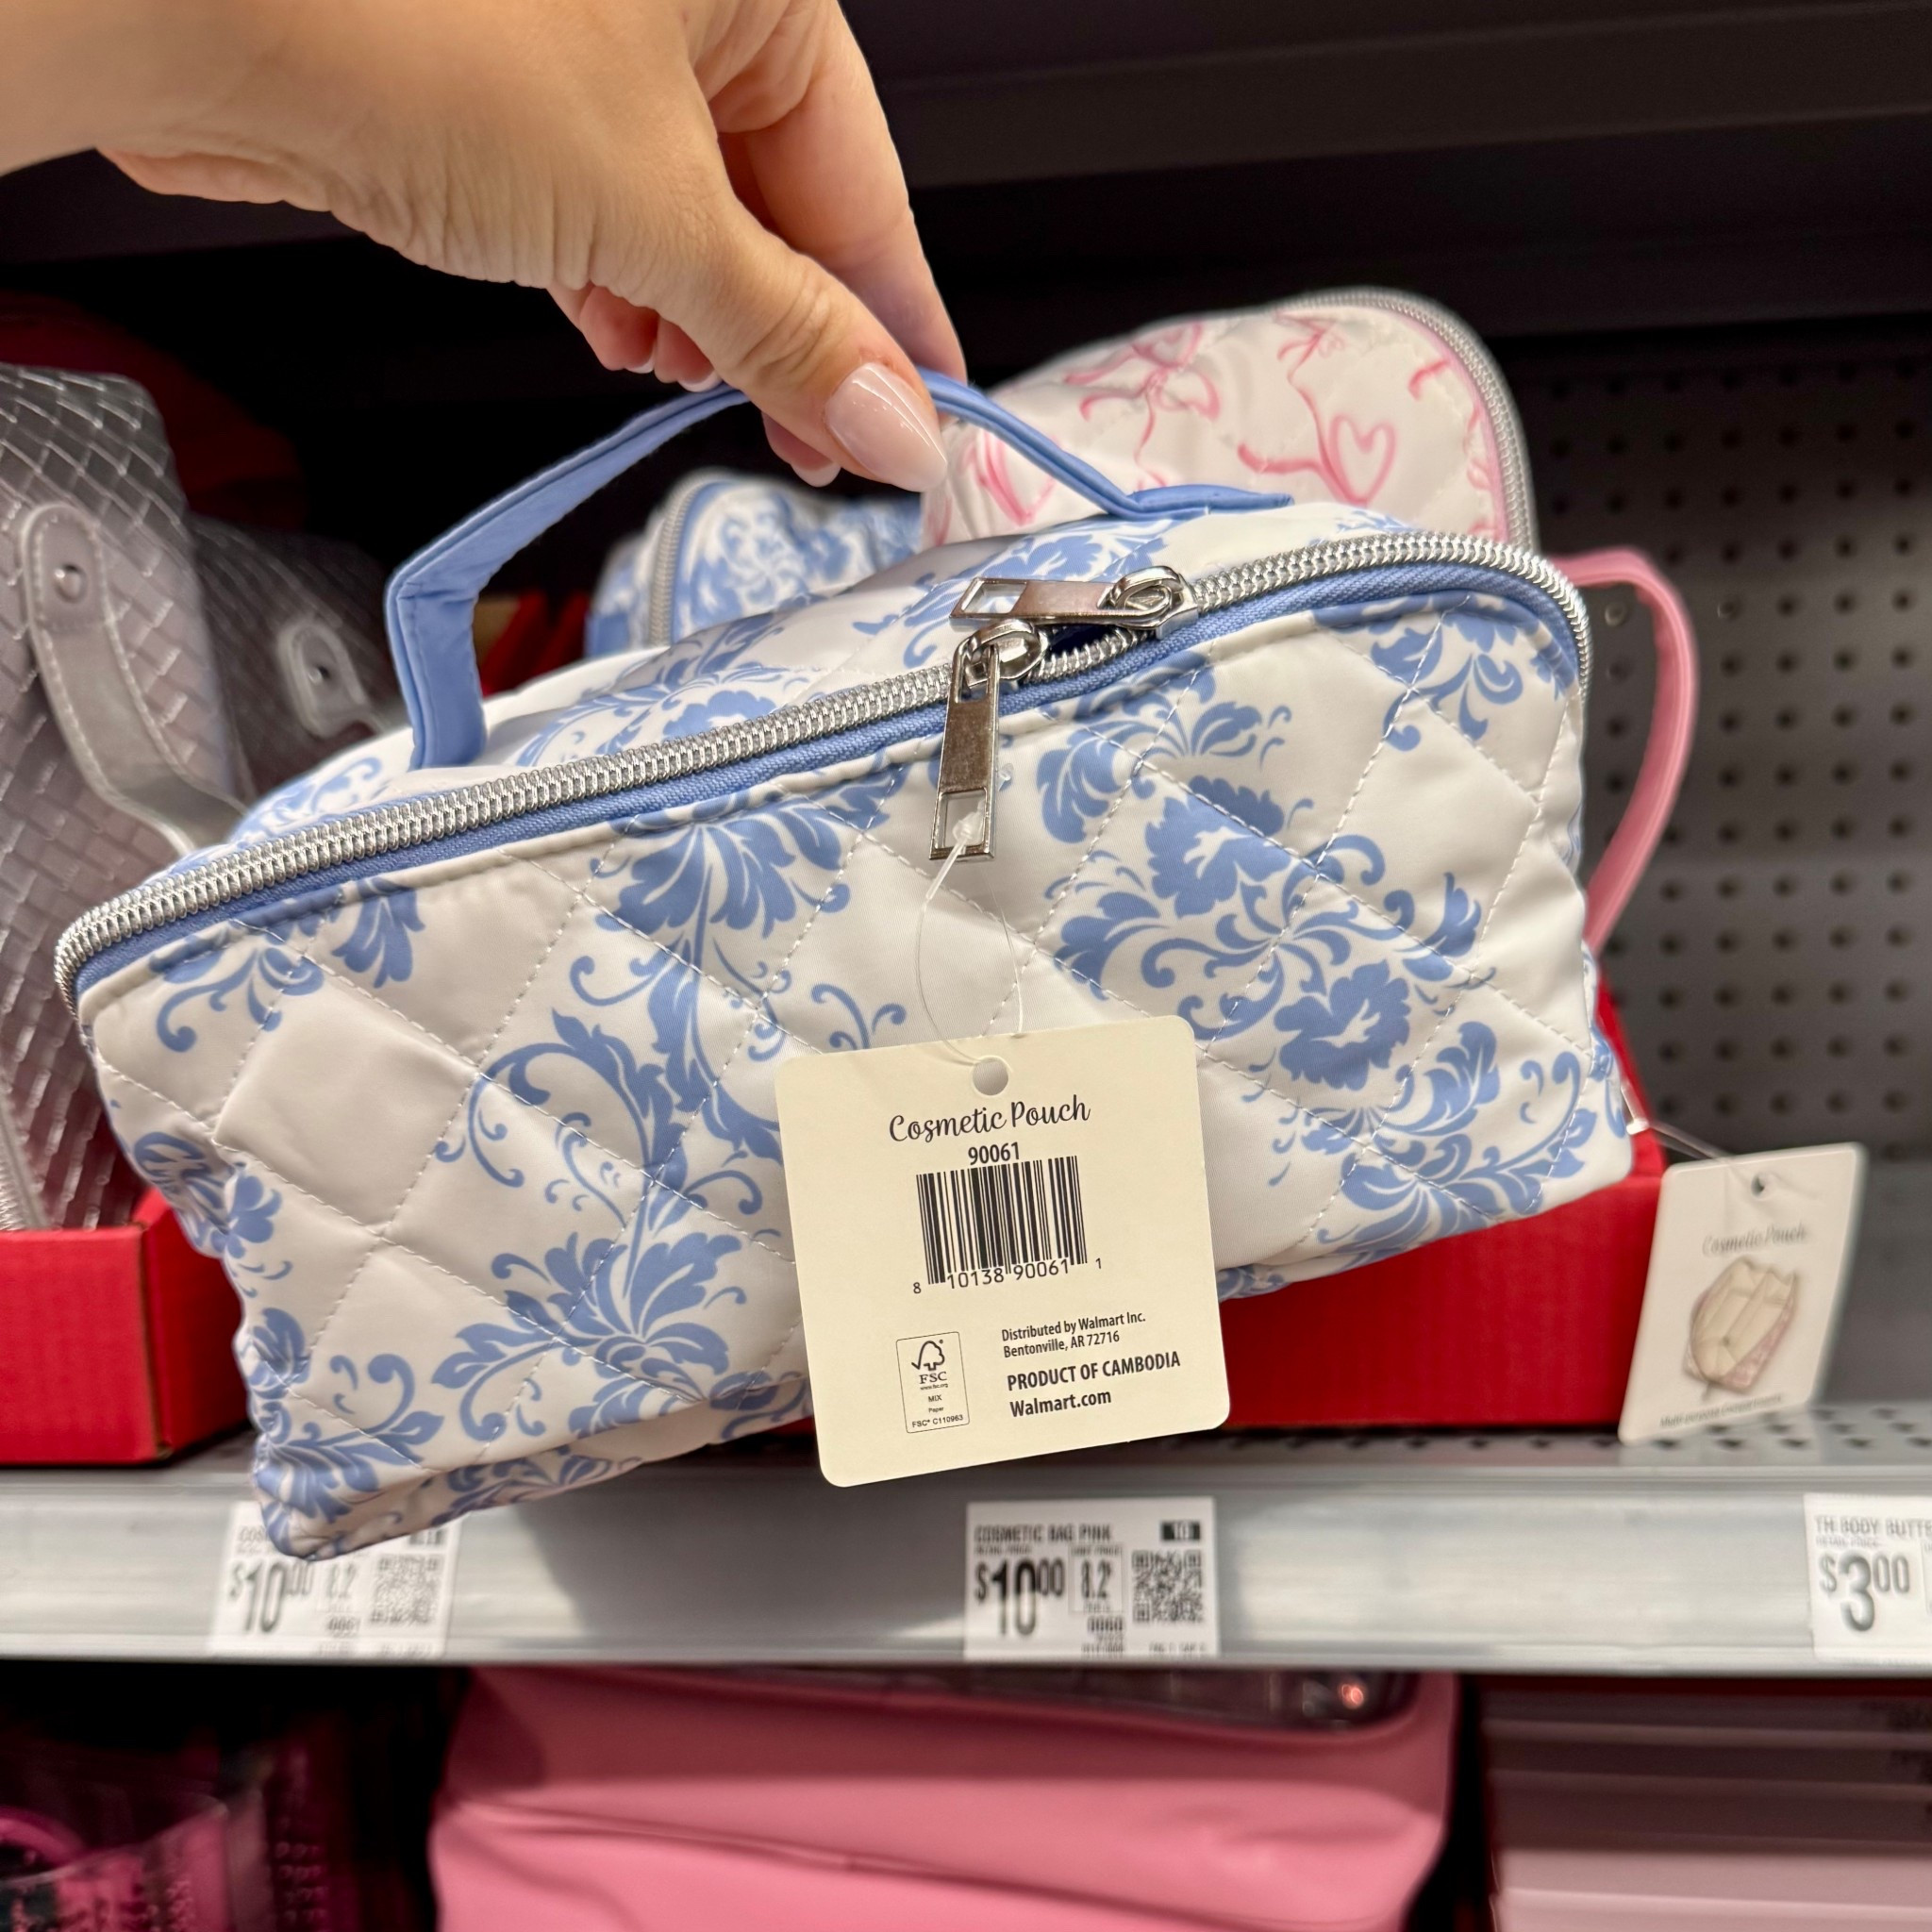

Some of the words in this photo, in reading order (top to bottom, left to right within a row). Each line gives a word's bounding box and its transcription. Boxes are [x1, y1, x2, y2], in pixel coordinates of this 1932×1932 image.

[889, 1107, 1007, 1142] Cosmetic
[1010, 1094, 1091, 1127] Pouch
[968, 1141, 1020, 1165] 90061
[913, 1282, 922, 1294] 8
[947, 1268, 1005, 1289] 10138
[1013, 1258, 1069, 1280] 90061
[1095, 1257, 1102, 1270] 1
[1001, 1322, 1061, 1341] Distributed
[1063, 1321, 1076, 1335] by
[1078, 1314, 1124, 1331] Walmart
[1126, 1311, 1146, 1324] Inc.
[1003, 1338, 1068, 1358] Bentonville,
[1071, 1335, 1085, 1349] AR
[1087, 1330, 1120, 1346] 72716
[919, 1371, 947, 1384] FSC
[1007, 1365, 1076, 1391] PRODUCT
[1080, 1362, 1098, 1380] OF
[1102, 1351, 1181, 1377] CAMBODIA
[927, 1394, 942, 1403] MIX
[1009, 1391, 1112, 1417] Walmart.com
[932, 1414, 964, 1425] C110963
[974, 1524, 1042, 1542] COSMETIC
[1079, 1524, 1111, 1541] PINK
[1840, 1517, 1879, 1535] BODY
